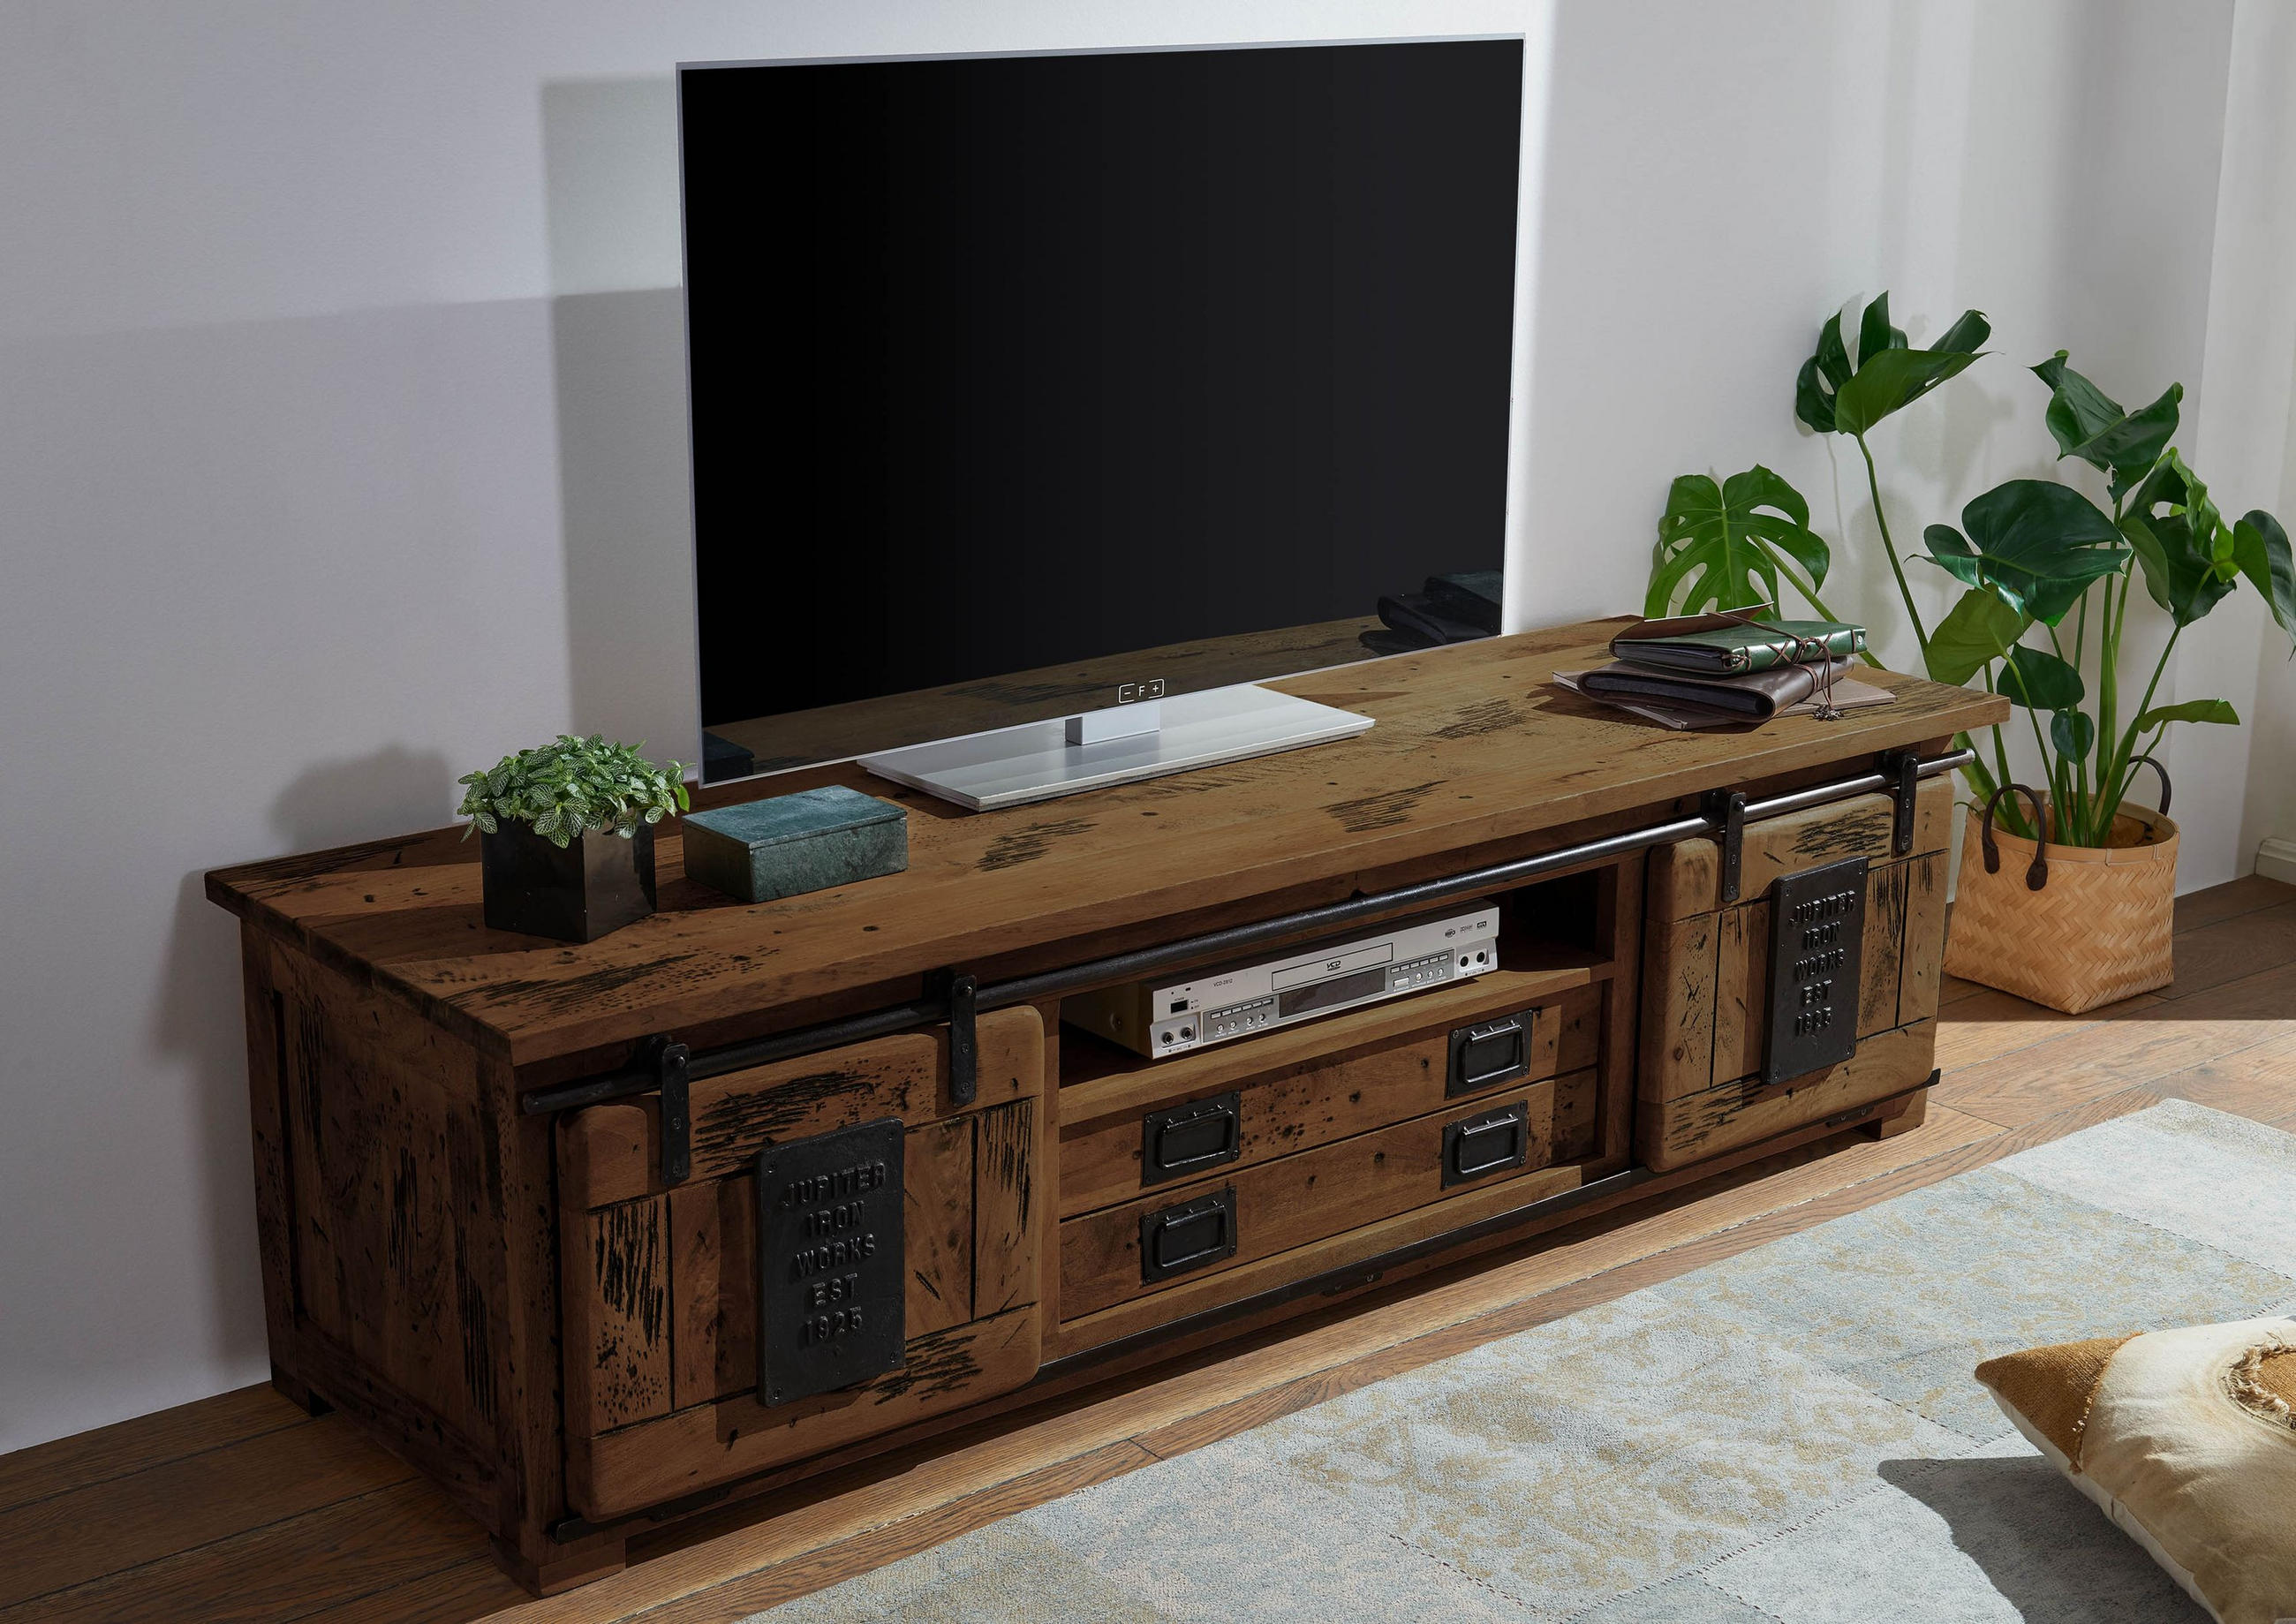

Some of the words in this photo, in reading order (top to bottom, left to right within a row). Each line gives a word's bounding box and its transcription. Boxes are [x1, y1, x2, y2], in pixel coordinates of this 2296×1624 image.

[1788, 889, 1855, 927] JUPITER
[1803, 920, 1842, 949] IRON
[1794, 947, 1844, 982] WORKS
[1801, 978, 1832, 1007] EST
[782, 1161, 885, 1208] JUPITER
[807, 1199, 865, 1237] IRON
[796, 1232, 875, 1278] WORKS
[812, 1272, 858, 1307] EST
